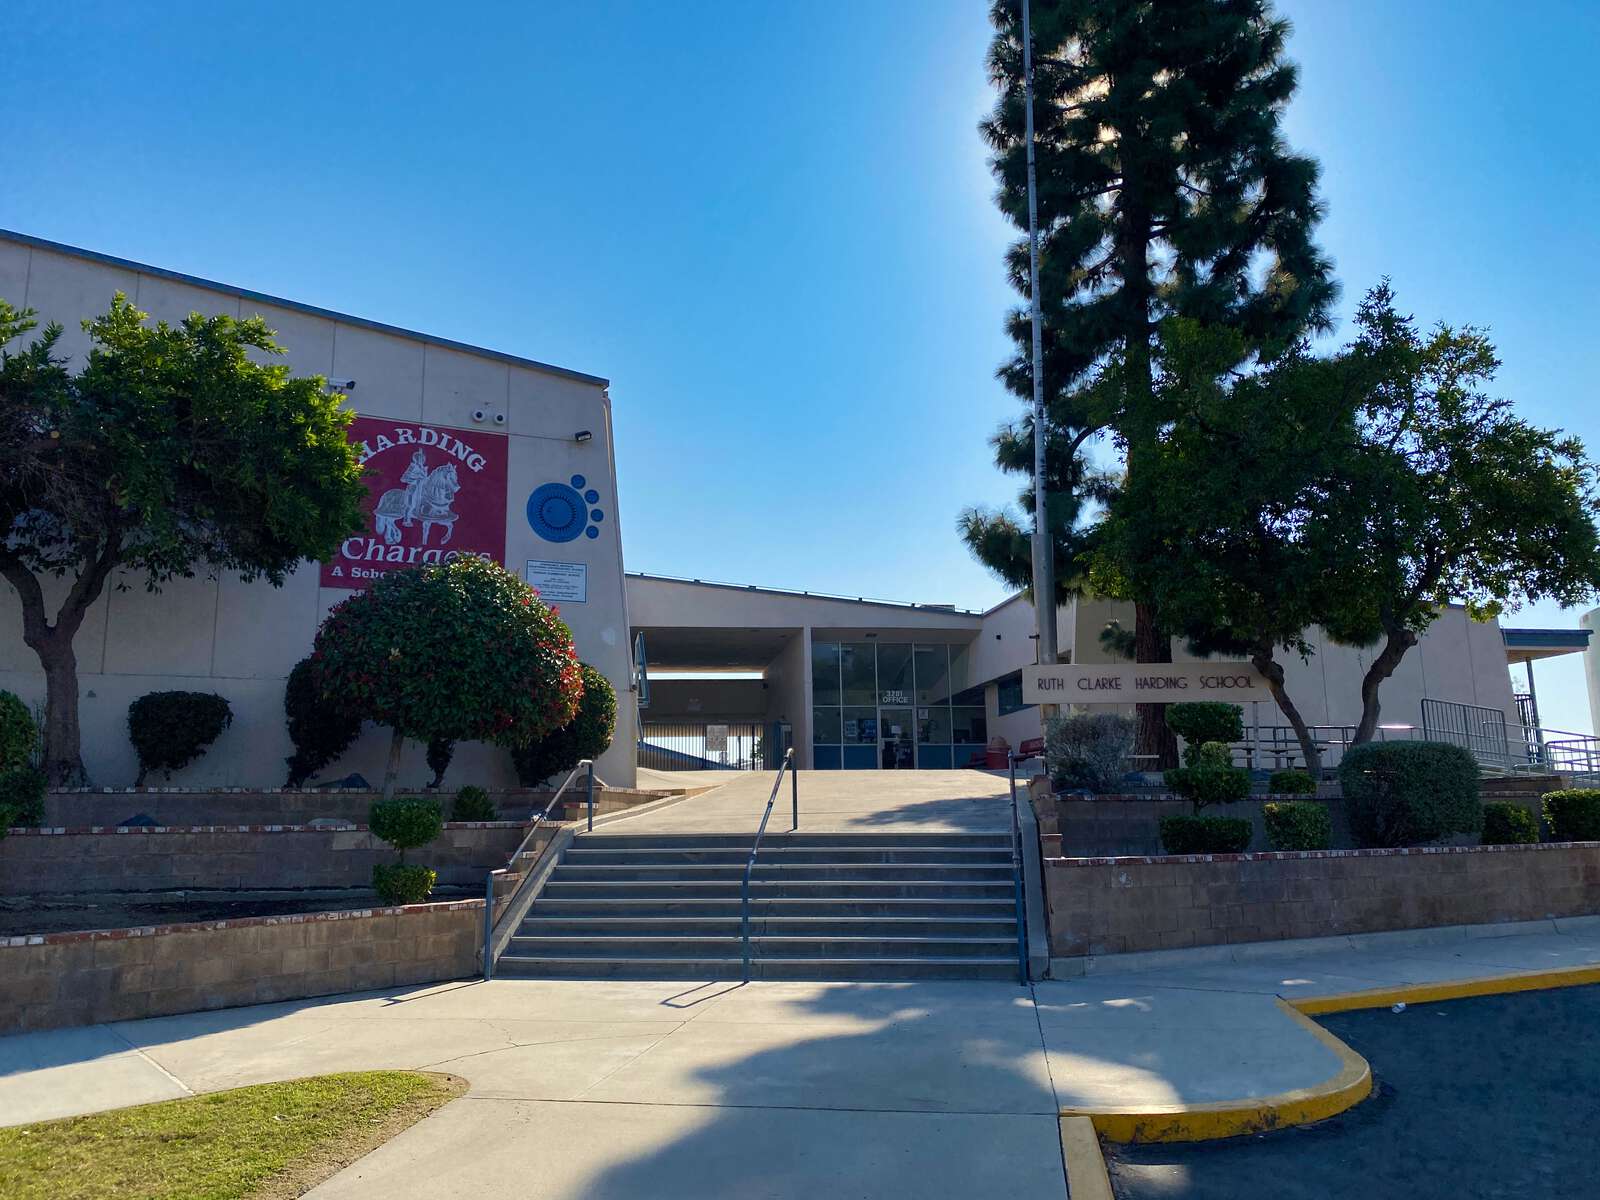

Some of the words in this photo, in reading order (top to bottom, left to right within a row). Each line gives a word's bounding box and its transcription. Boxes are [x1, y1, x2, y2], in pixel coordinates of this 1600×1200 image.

[331, 566, 343, 577] A
[351, 567, 387, 579] Sch
[1037, 677, 1064, 690] RUTH
[1077, 677, 1122, 690] CLARKE
[1135, 676, 1188, 689] HARDING
[1199, 675, 1256, 689] SCHOOL
[882, 696, 909, 704] OFFICE
